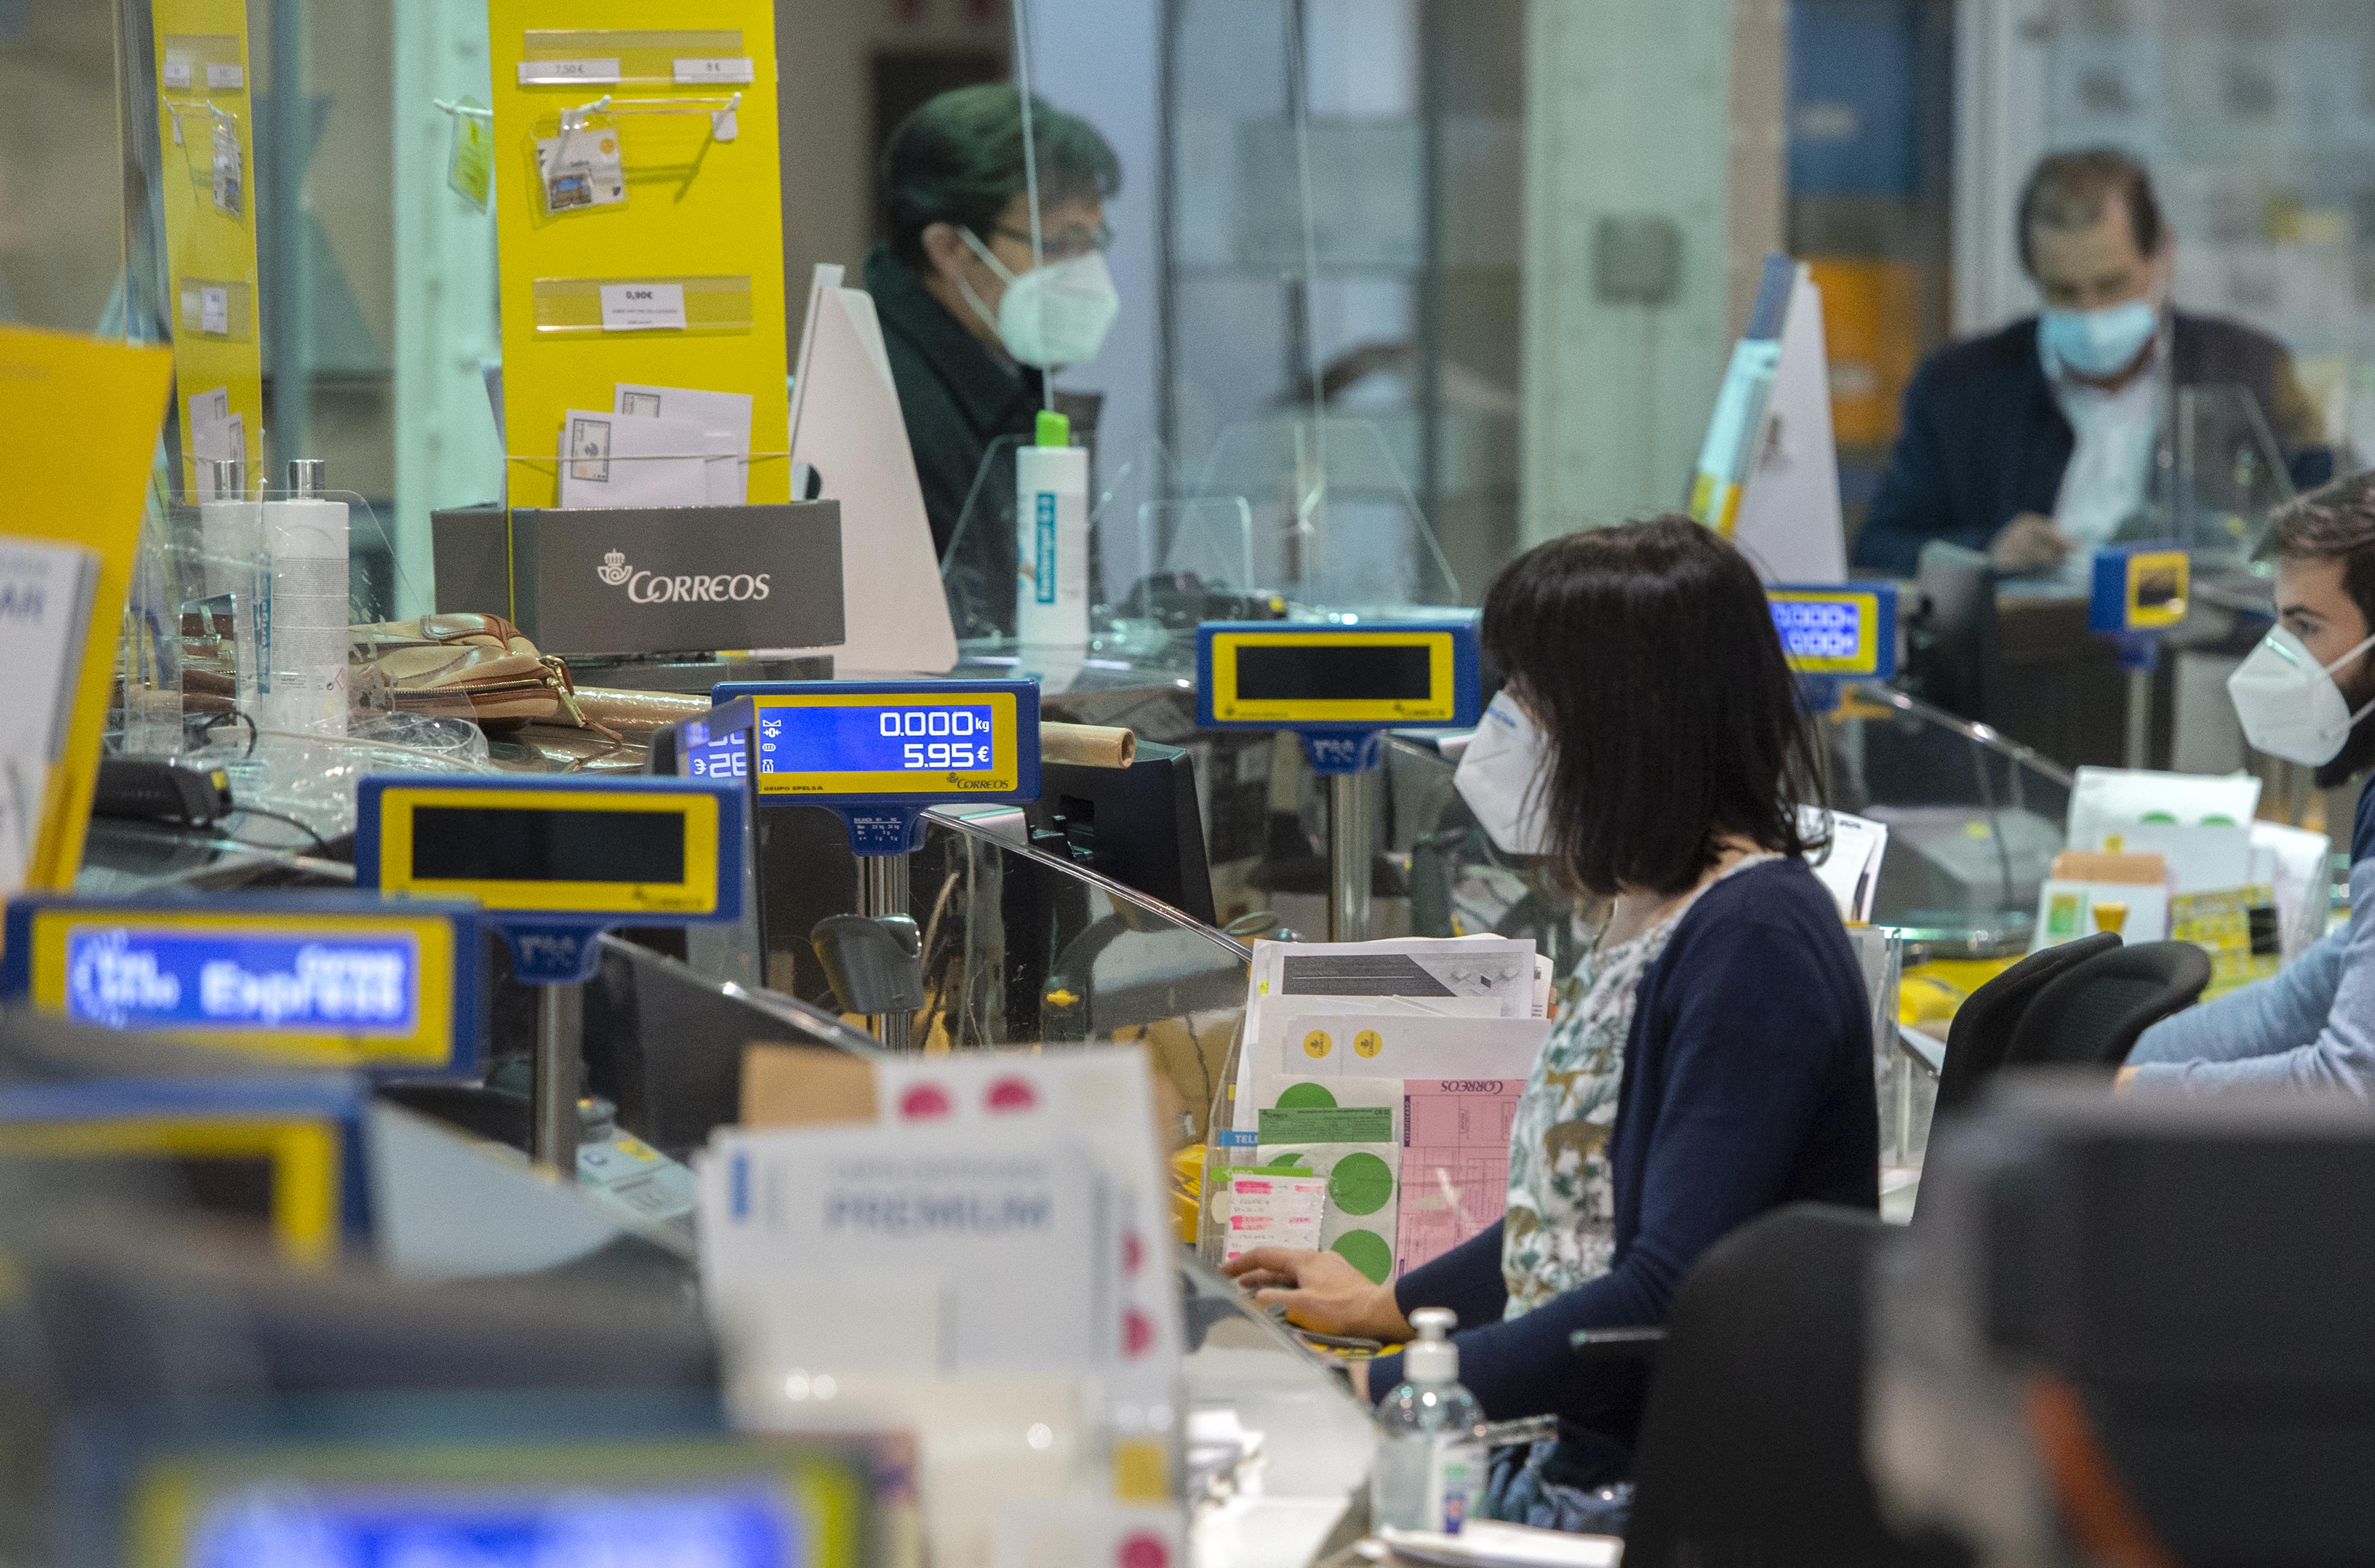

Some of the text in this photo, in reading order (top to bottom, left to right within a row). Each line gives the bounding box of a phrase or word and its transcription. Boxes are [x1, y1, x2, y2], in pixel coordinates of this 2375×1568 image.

[628, 570, 770, 603] CORREOS
[880, 712, 989, 737] 0.000 kg
[904, 743, 989, 768] 5.95 €
[957, 778, 1009, 789] CORREOS
[1441, 1081, 1504, 1094] CORREOS
